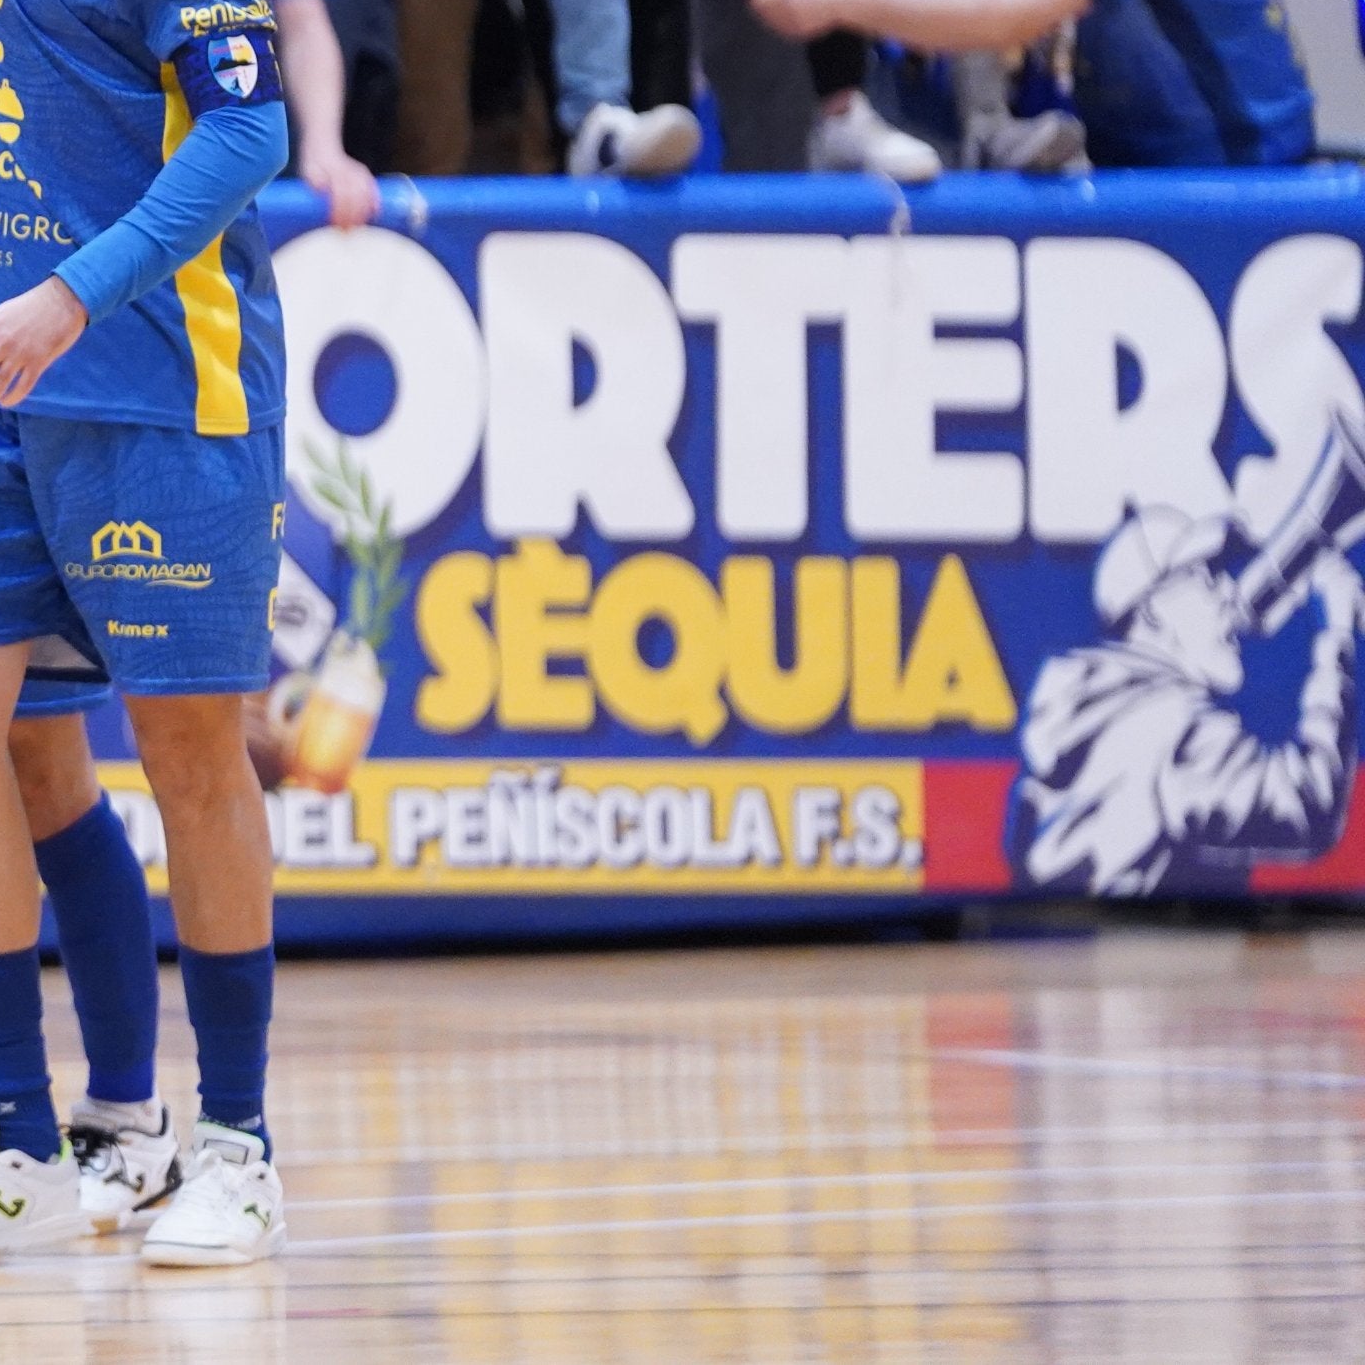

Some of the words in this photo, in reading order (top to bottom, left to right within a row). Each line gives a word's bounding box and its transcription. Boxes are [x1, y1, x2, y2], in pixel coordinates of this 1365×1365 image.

[272, 226, 1365, 544] ORTERS
[415, 536, 1018, 746] SÈQUIA
[272, 787, 376, 868] EL
[391, 766, 783, 870] PEÑÍSCOLA
[792, 785, 925, 872] F.S.
